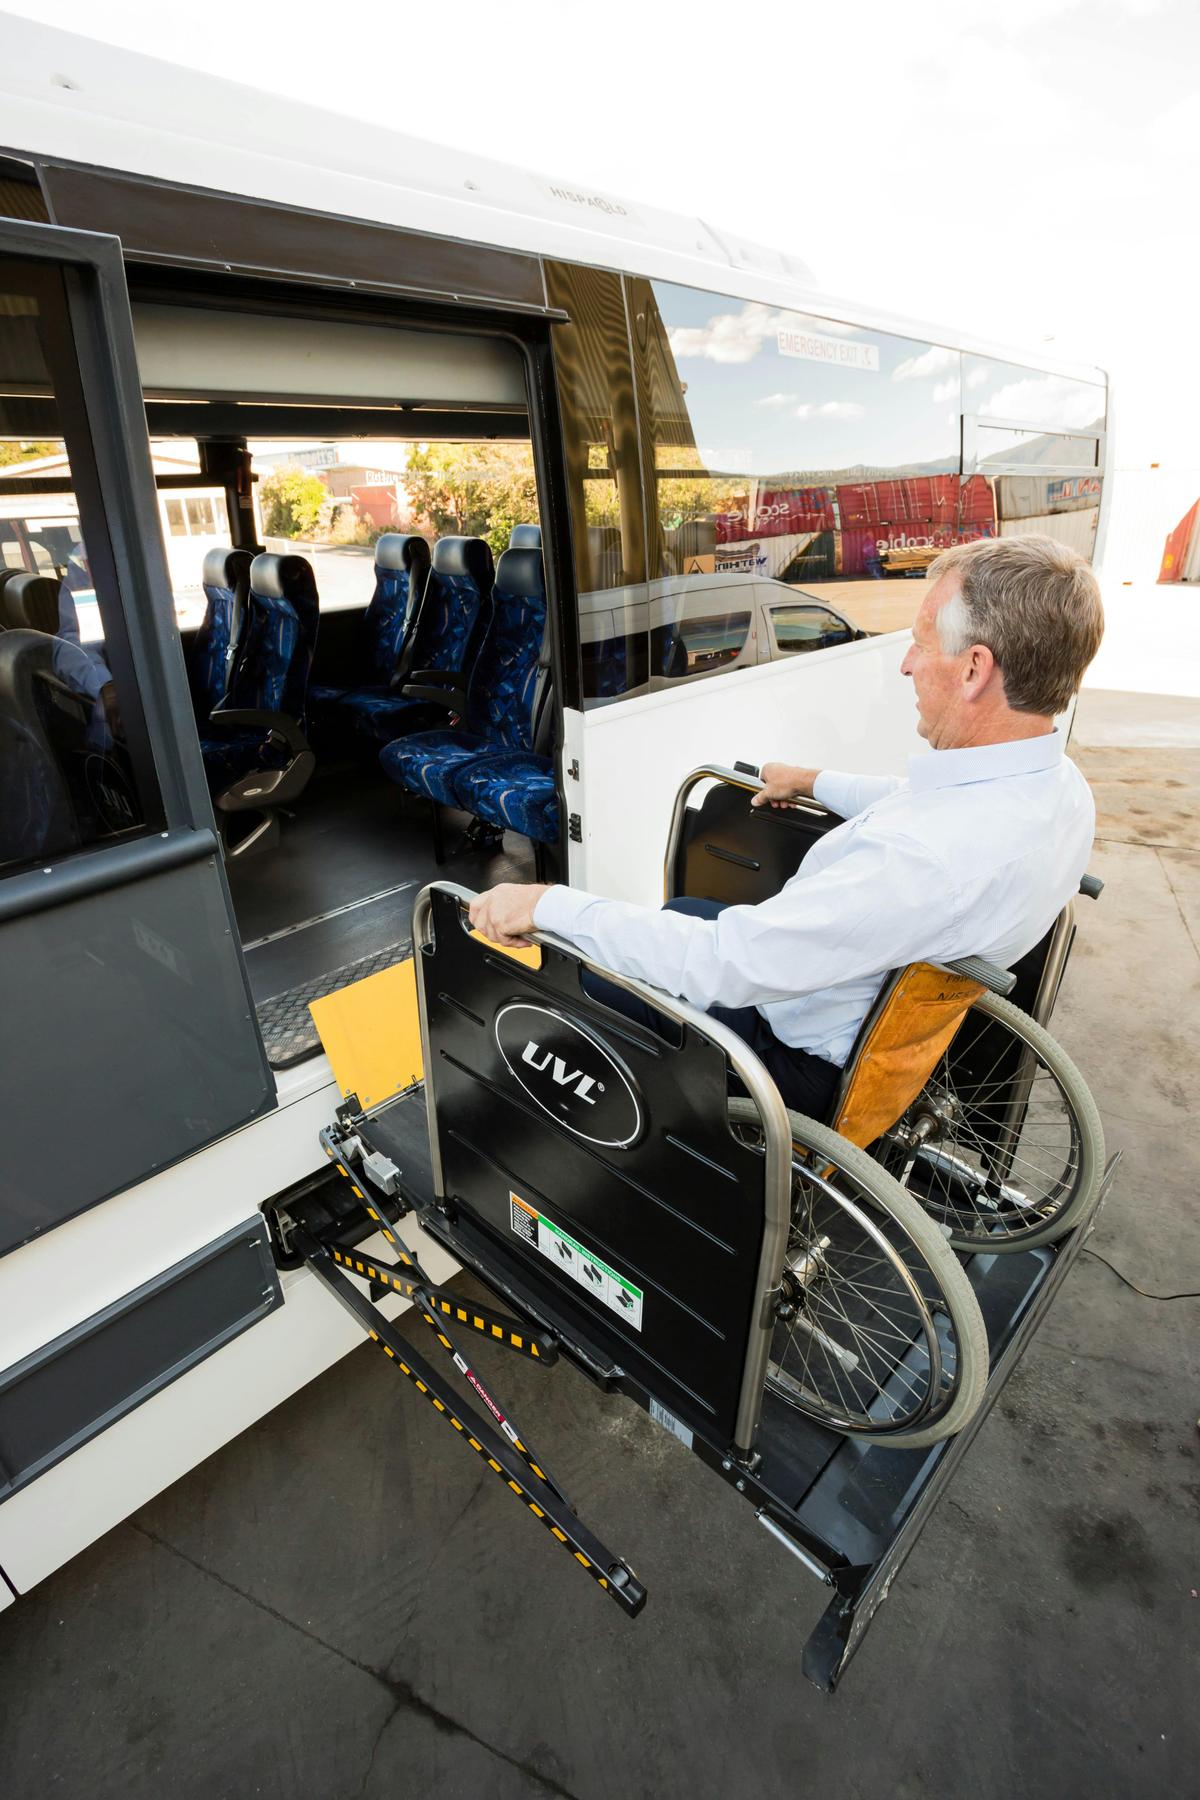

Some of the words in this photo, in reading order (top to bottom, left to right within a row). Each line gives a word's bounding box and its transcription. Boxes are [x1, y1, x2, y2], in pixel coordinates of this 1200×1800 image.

[778, 332, 838, 361] EMERGENCY
[839, 343, 858, 364] EXIT
[581, 1249, 622, 1283] INSTRUCTIONS
[475, 1384, 502, 1418] DANGER
